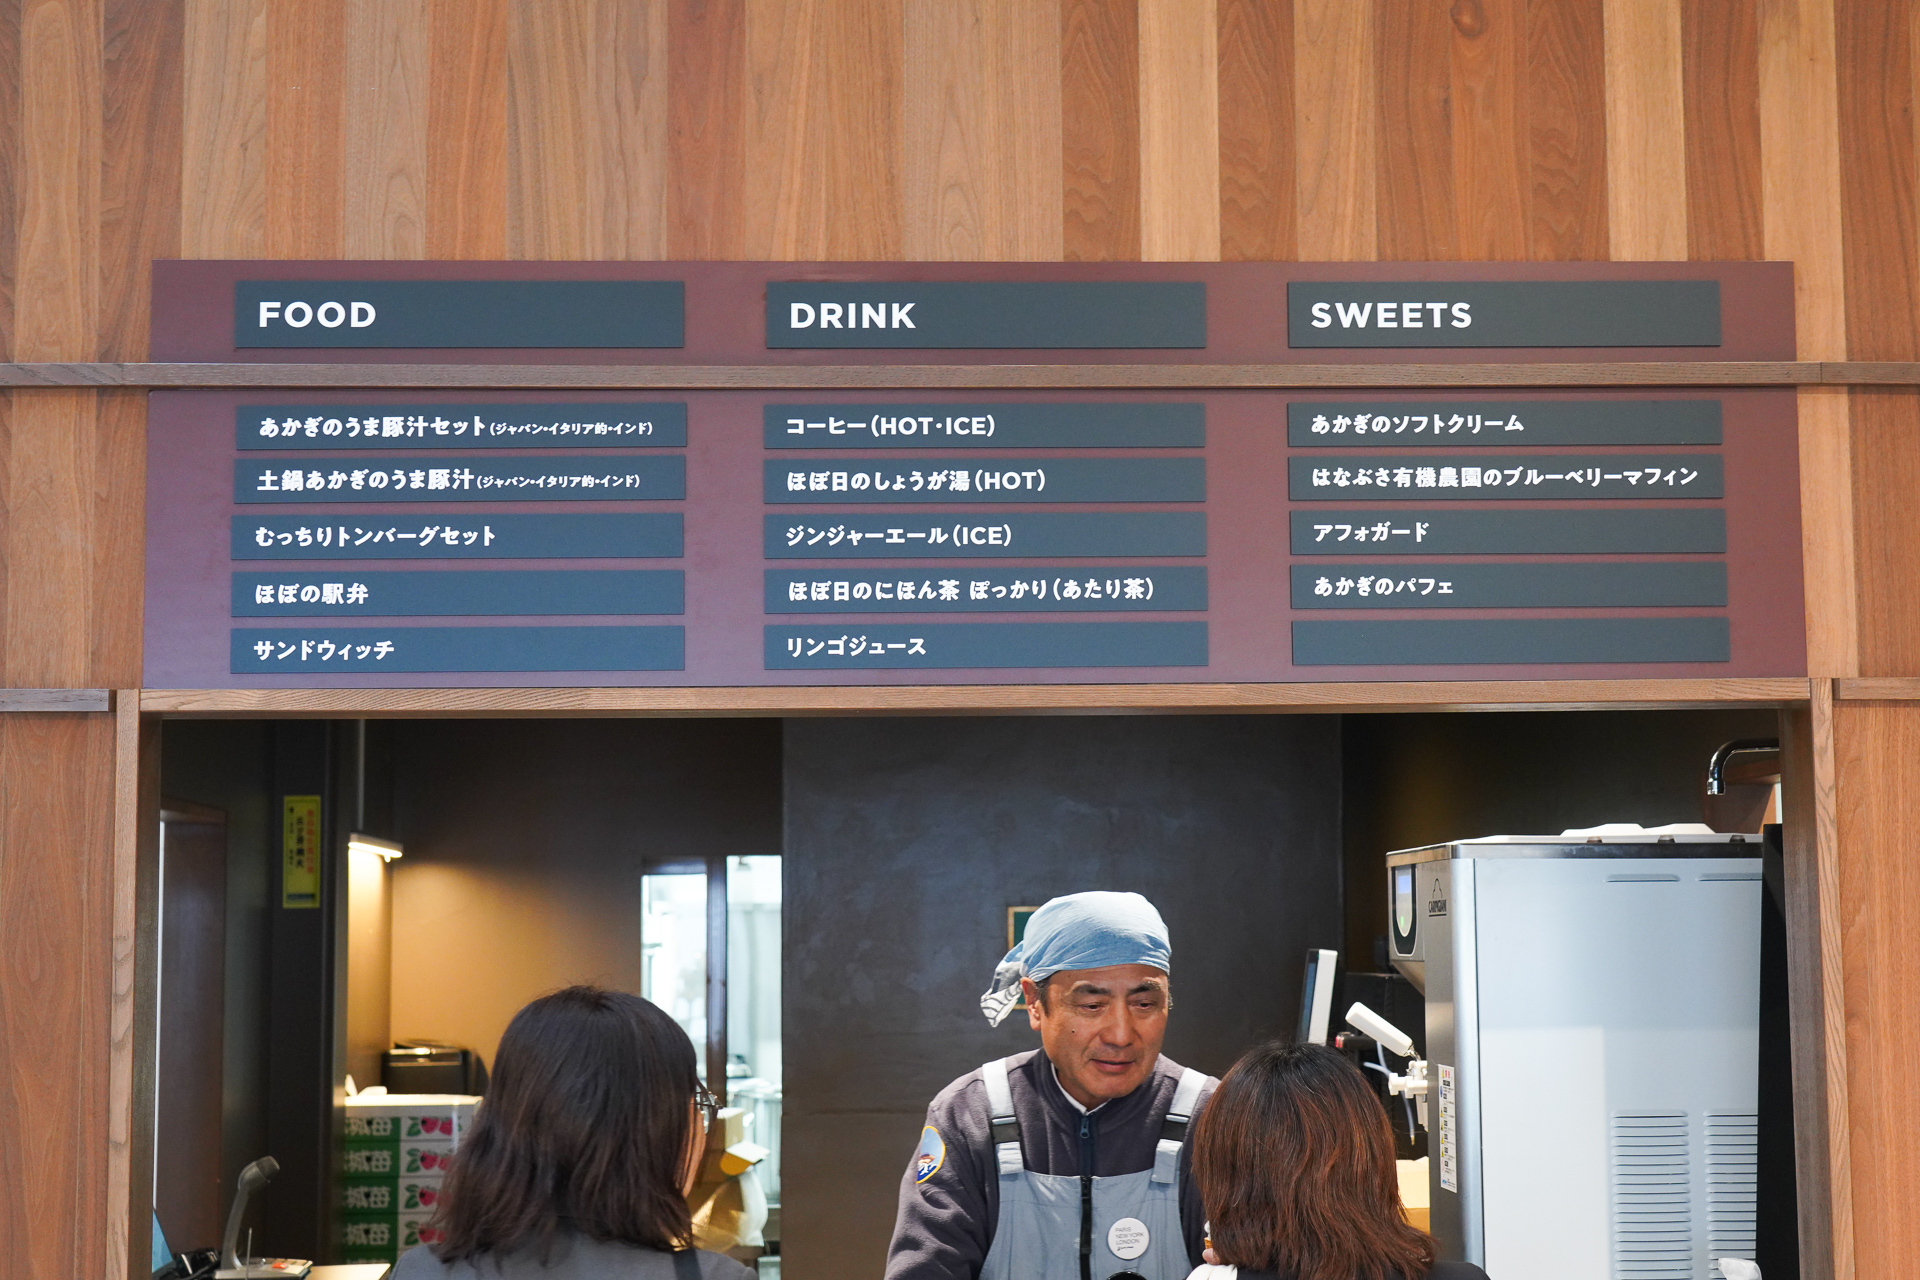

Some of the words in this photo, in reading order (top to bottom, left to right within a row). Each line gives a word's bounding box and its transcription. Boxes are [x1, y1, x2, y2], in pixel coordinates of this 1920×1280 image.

[259, 301, 377, 328] FOOD
[790, 302, 917, 329] DRINK
[1310, 302, 1472, 329] SWEETS
[1310, 413, 1525, 435] あかぎのソフトクリーム
[1312, 465, 1698, 488] はなぶさ有機農園のブルーベリーマフィン
[255, 525, 496, 548] むっちりトンバーグセット
[1313, 520, 1430, 543] アフォガード
[255, 582, 369, 605] ほぼの駅弁
[788, 577, 960, 603] ほぼ日のにほん茶
[1313, 575, 1454, 597] あかぎのパフェ
[253, 639, 395, 661] サンドウィッチ
[787, 634, 927, 658] リンゴジュース
[344, 1116, 392, 1137] 城苗
[344, 1150, 392, 1173] 城苗
